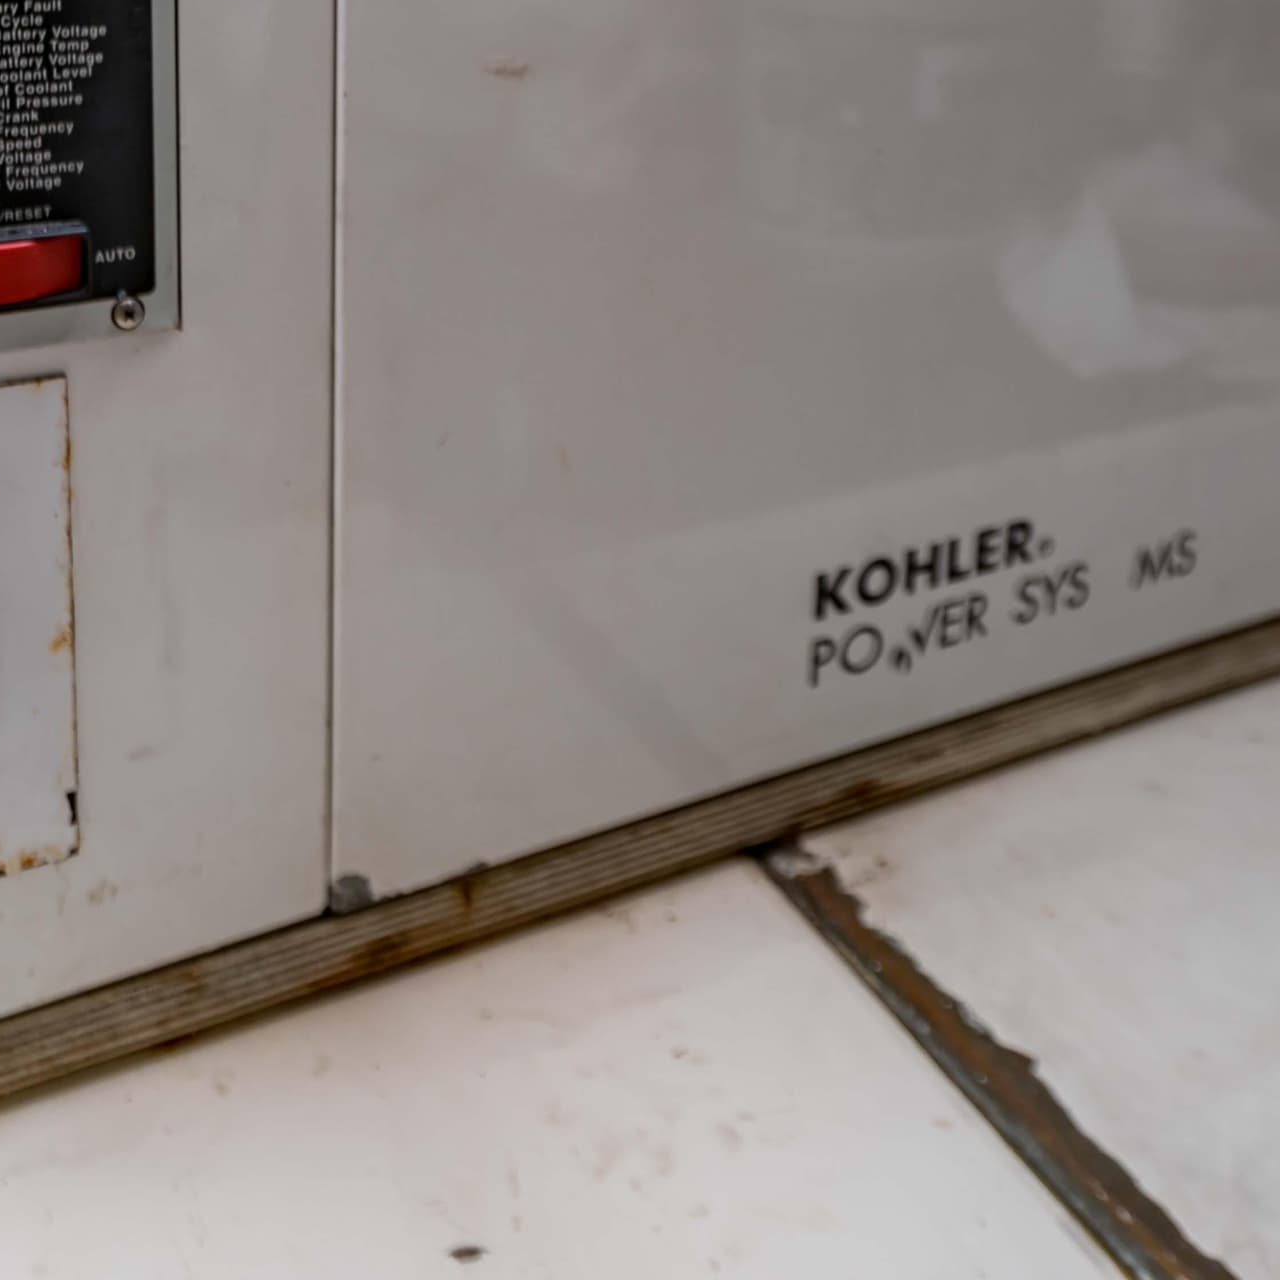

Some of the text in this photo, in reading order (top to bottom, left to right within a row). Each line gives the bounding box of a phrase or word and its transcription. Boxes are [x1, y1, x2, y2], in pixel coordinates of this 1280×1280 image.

[0, 14, 44, 29] Cycle
[51, 24, 108, 40] Voltage
[50, 39, 90, 54] Temp
[49, 52, 104, 67] Voltage
[53, 65, 93, 80] Level
[14, 81, 73, 96] Coolant
[16, 94, 83, 109] Pressure
[6, 160, 84, 178] Frequency
[6, 176, 62, 191] Voltage
[95, 248, 136, 264] AUTO
